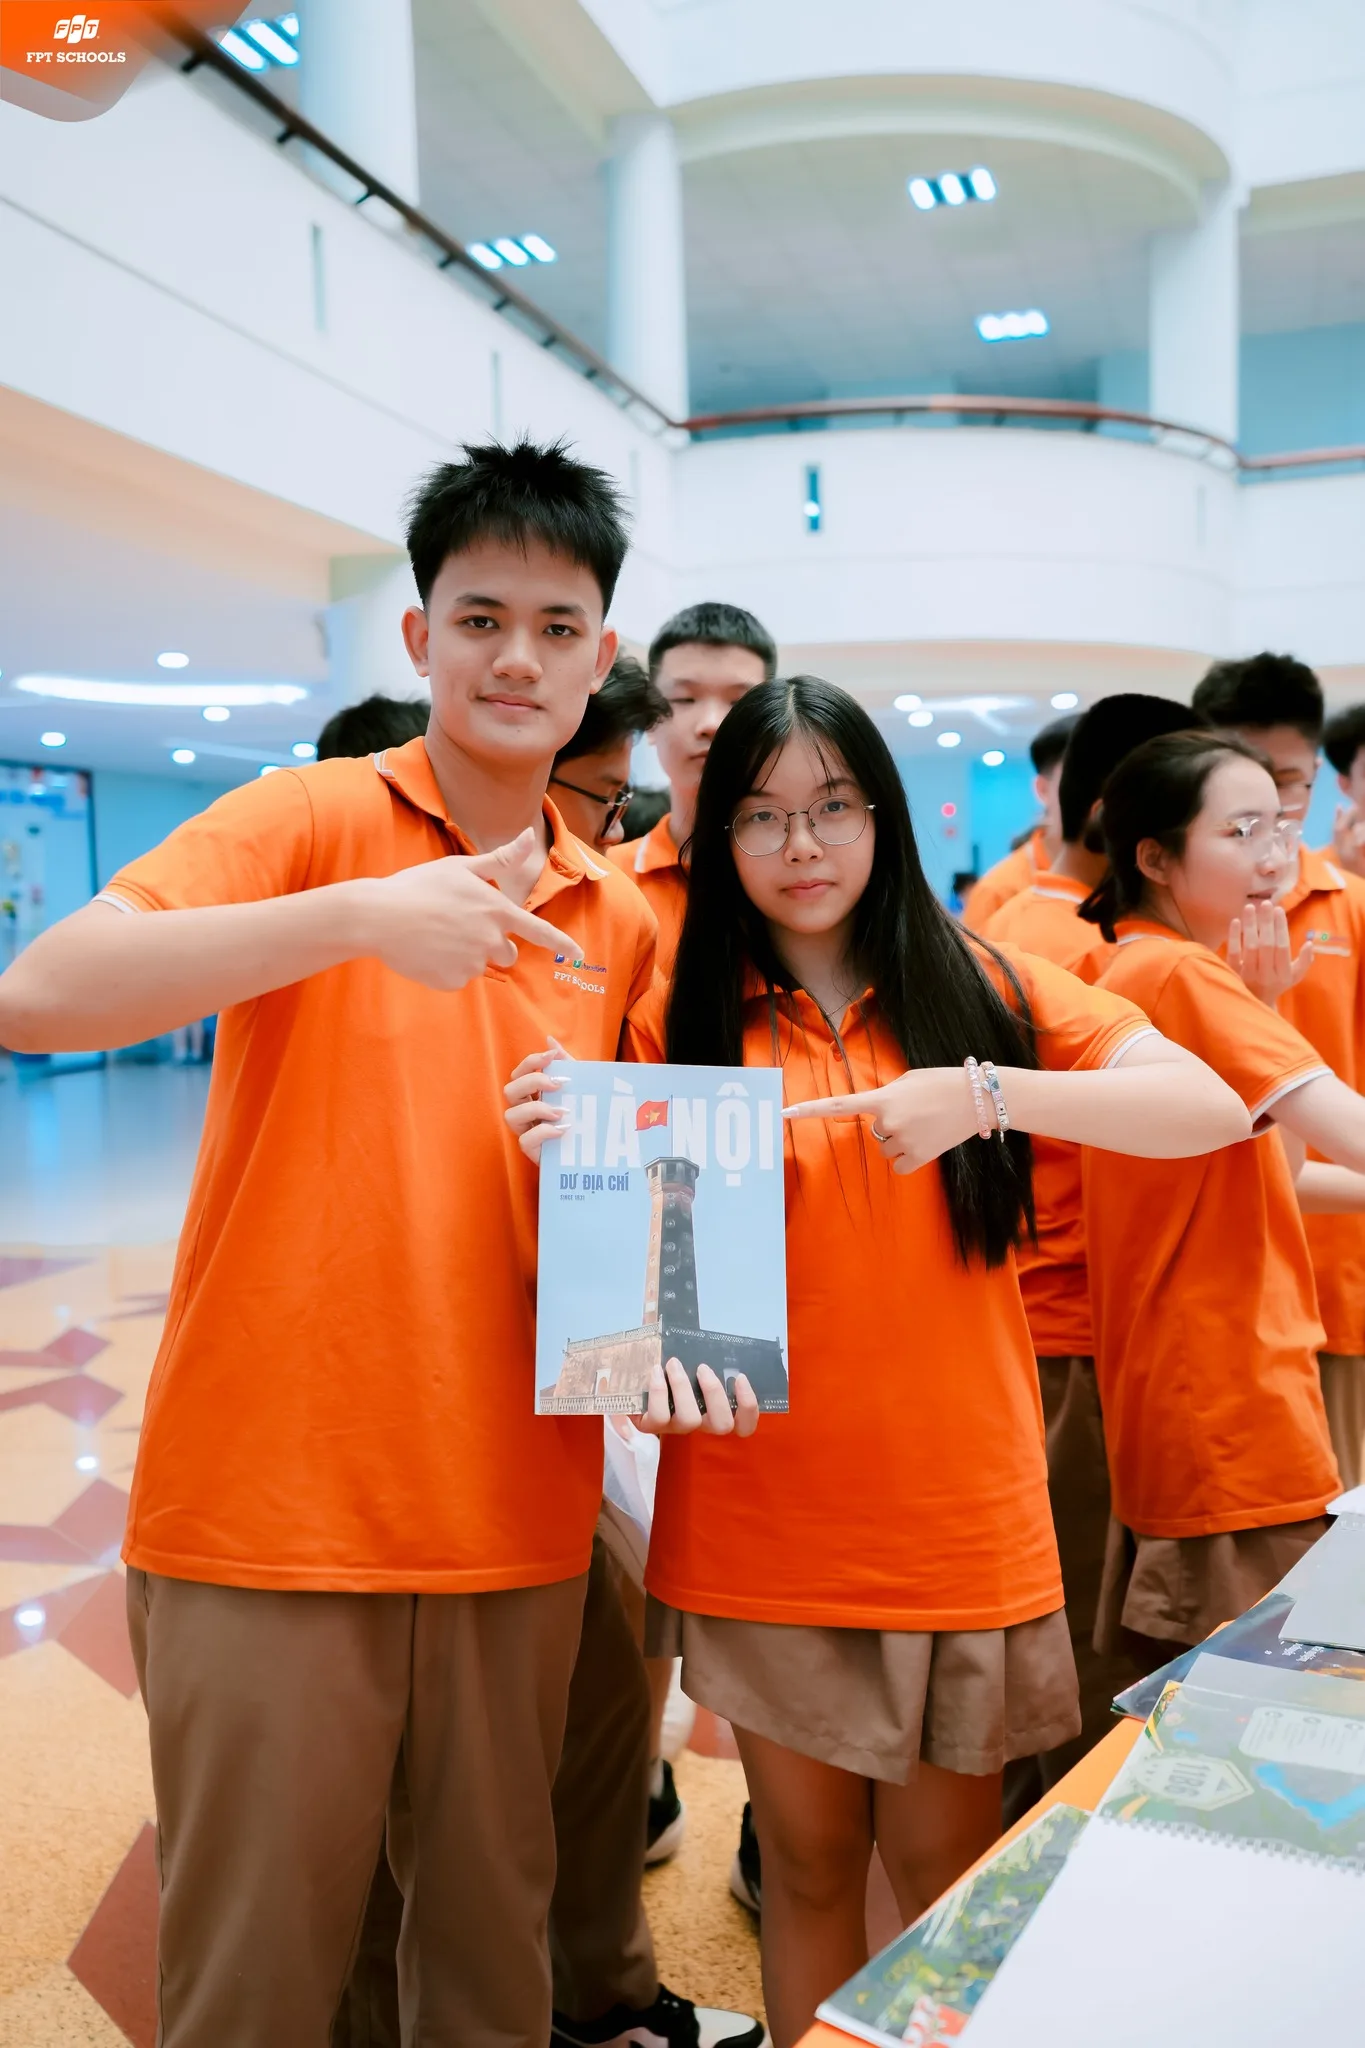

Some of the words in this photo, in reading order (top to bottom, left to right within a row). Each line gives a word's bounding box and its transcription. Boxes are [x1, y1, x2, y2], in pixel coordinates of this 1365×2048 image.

[554, 971, 572, 982] FPT
[560, 1076, 641, 1168] HÀ
[673, 1082, 774, 1187] NỘI
[560, 1173, 578, 1190] DƯ
[582, 1174, 604, 1194] ĐỊA
[608, 1171, 629, 1191] CHÍ
